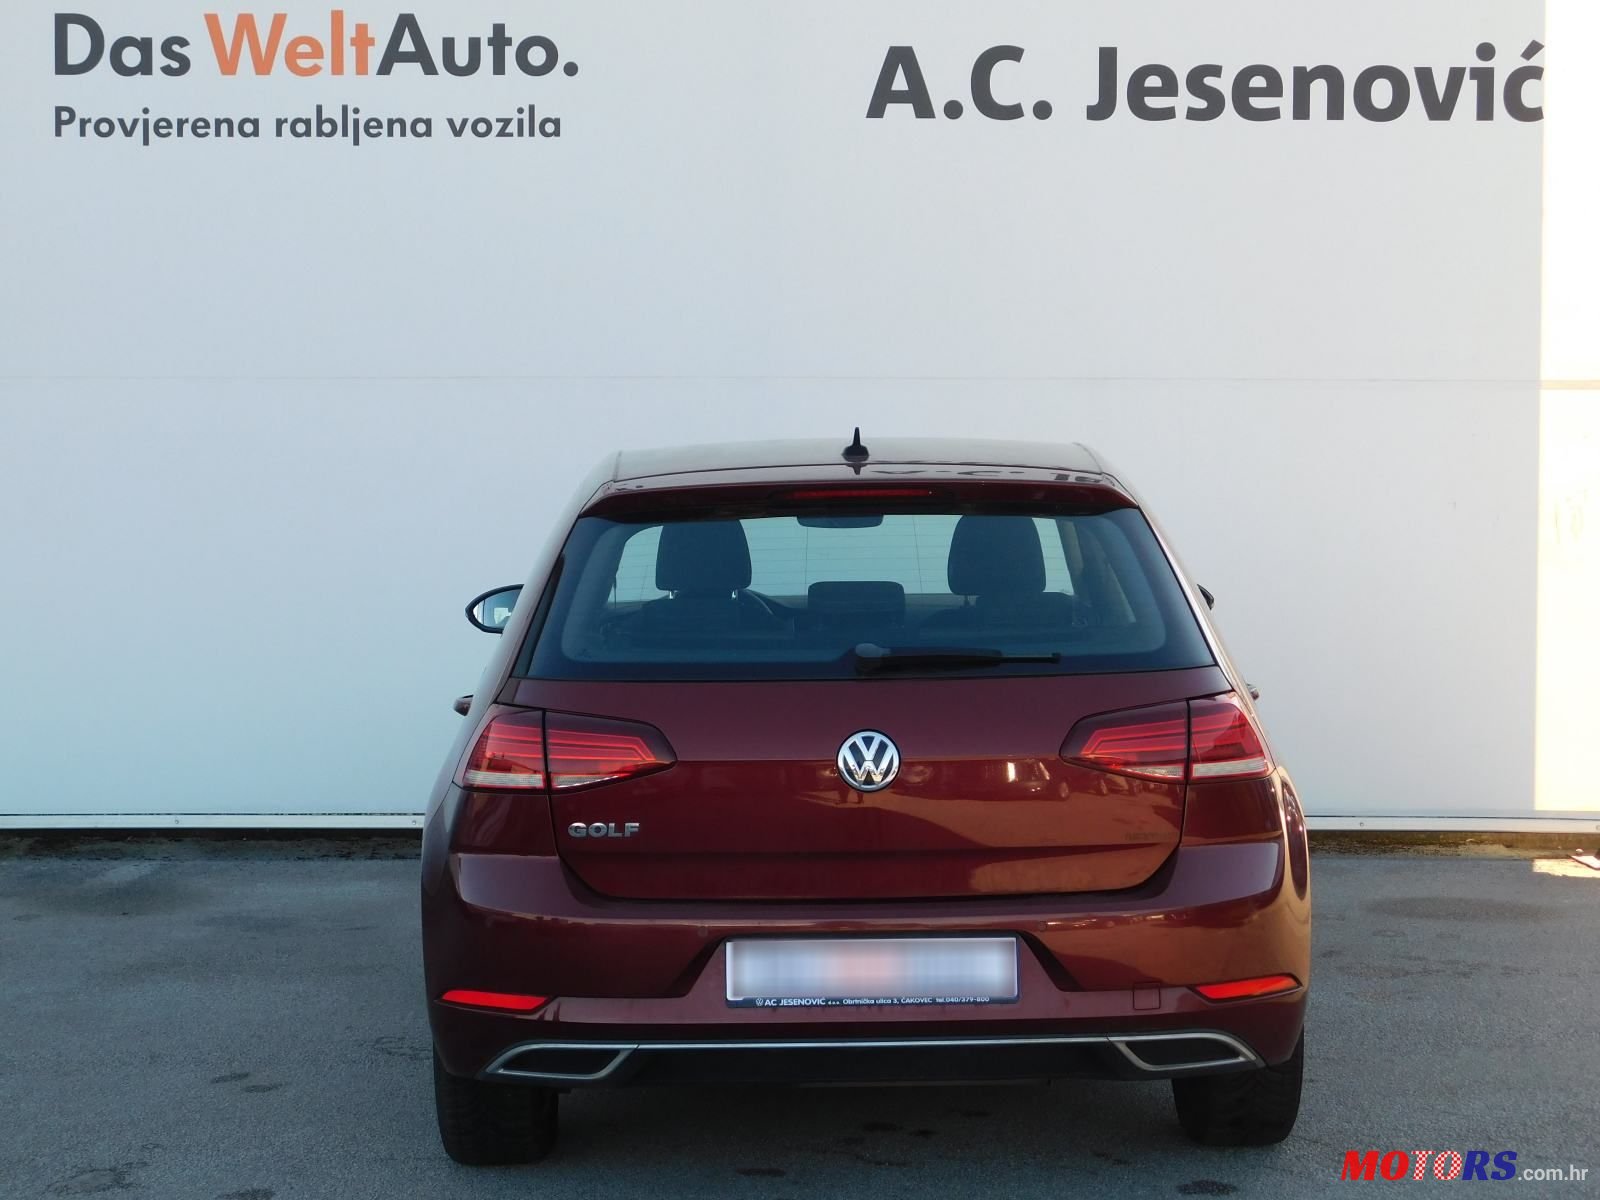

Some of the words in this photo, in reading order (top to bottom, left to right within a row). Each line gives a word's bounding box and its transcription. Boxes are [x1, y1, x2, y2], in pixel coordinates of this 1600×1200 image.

[55, 13, 190, 77] Das
[205, 10, 578, 76] WeltAuto.
[866, 45, 1052, 120] A.C.
[1087, 40, 1544, 122] Jesenović
[55, 106, 259, 146] Provjerena
[276, 104, 432, 146] rabljena
[447, 104, 560, 138] vozila
[568, 822, 640, 838] GOLF
[764, 998, 778, 1006] AC
[779, 996, 827, 1006] JESENOVIĆ
